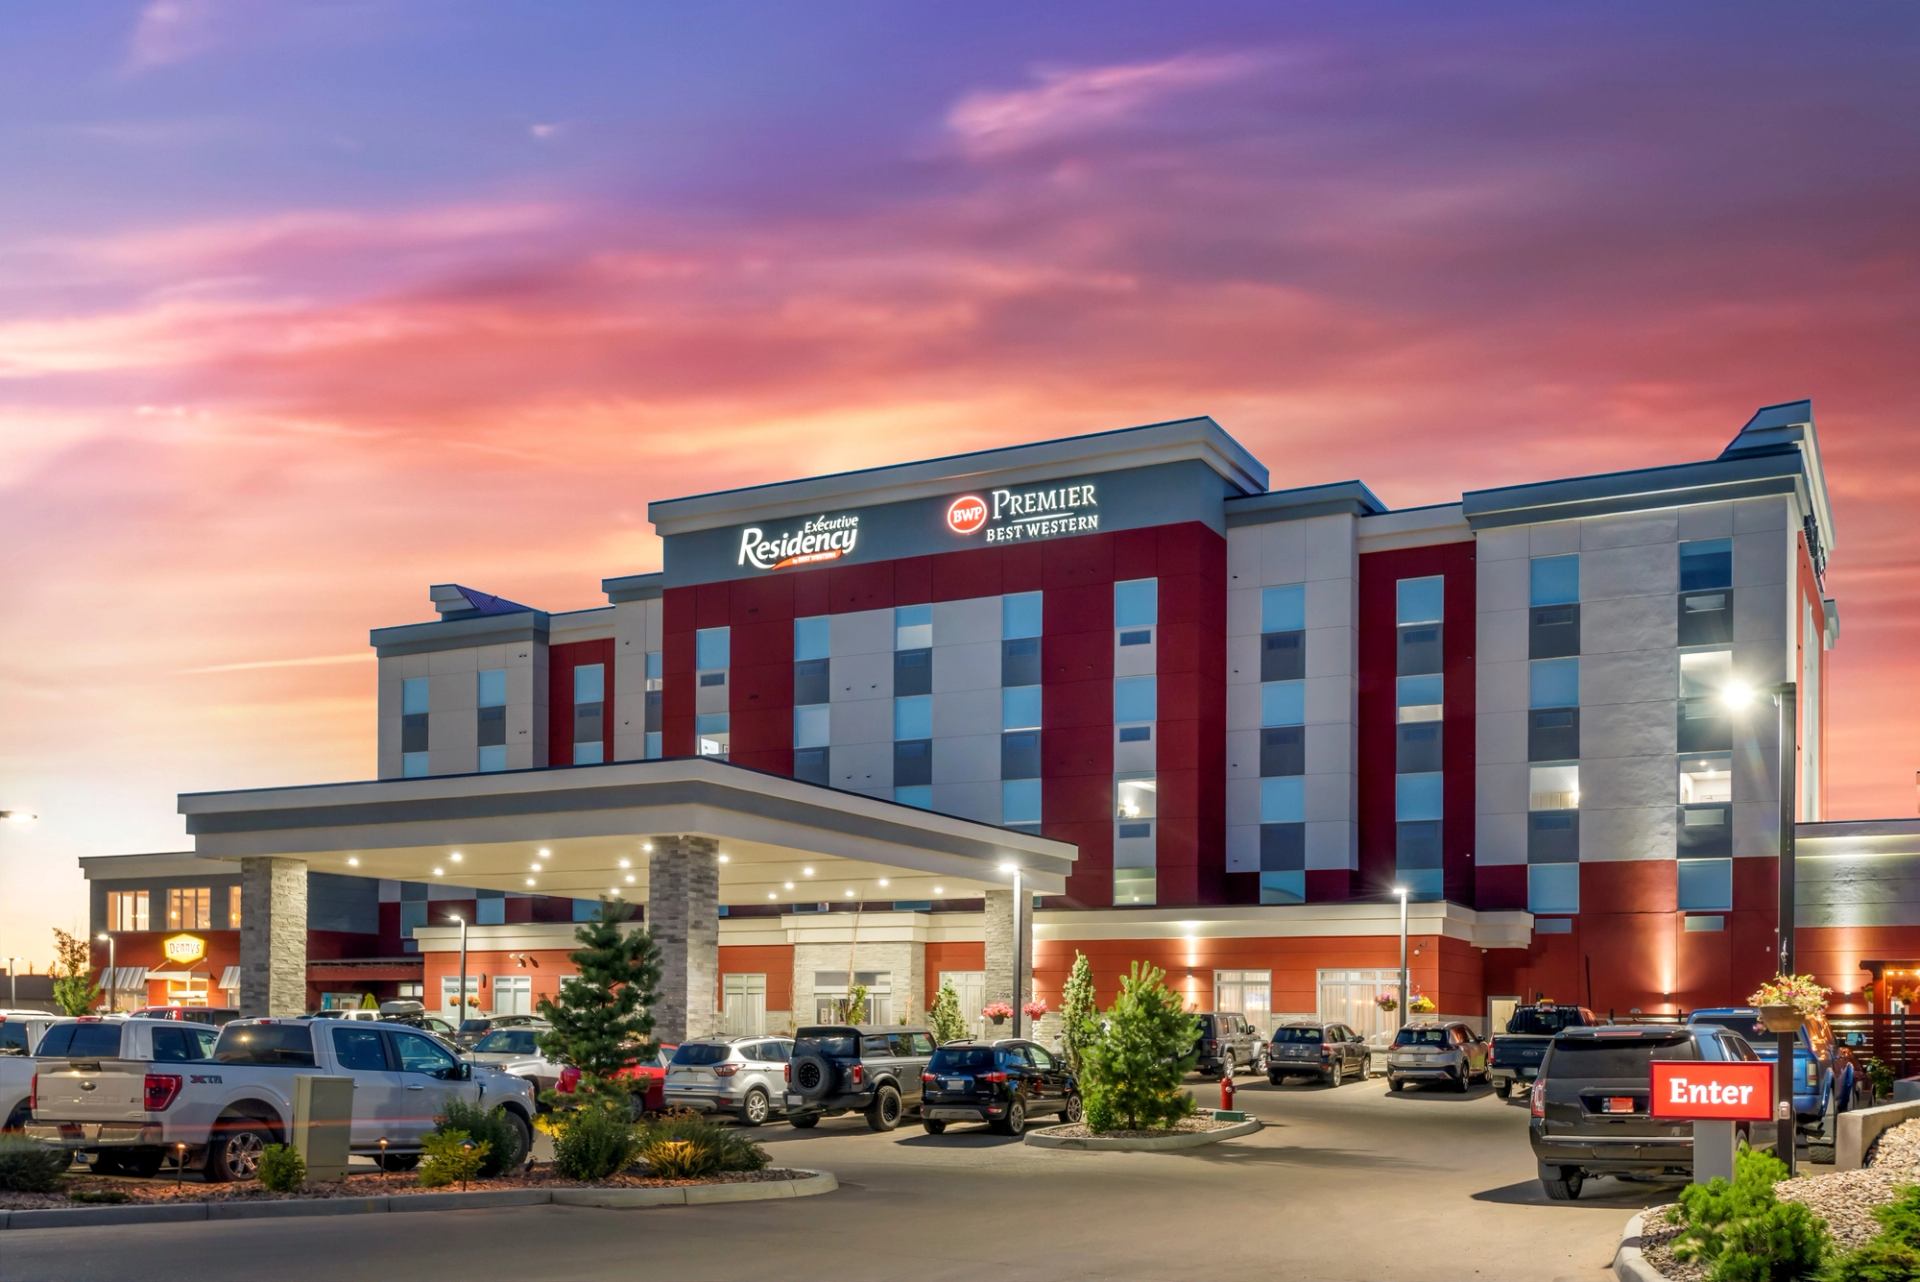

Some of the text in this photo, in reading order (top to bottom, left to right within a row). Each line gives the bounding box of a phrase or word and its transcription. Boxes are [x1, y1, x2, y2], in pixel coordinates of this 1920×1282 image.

[953, 506, 983, 523] BWP
[993, 485, 1097, 519] PREMIER
[987, 515, 1099, 542] BEST WESTERN
[738, 527, 858, 569] Residency
[169, 942, 200, 954] Dennys
[1669, 1078, 1754, 1105] Enter
